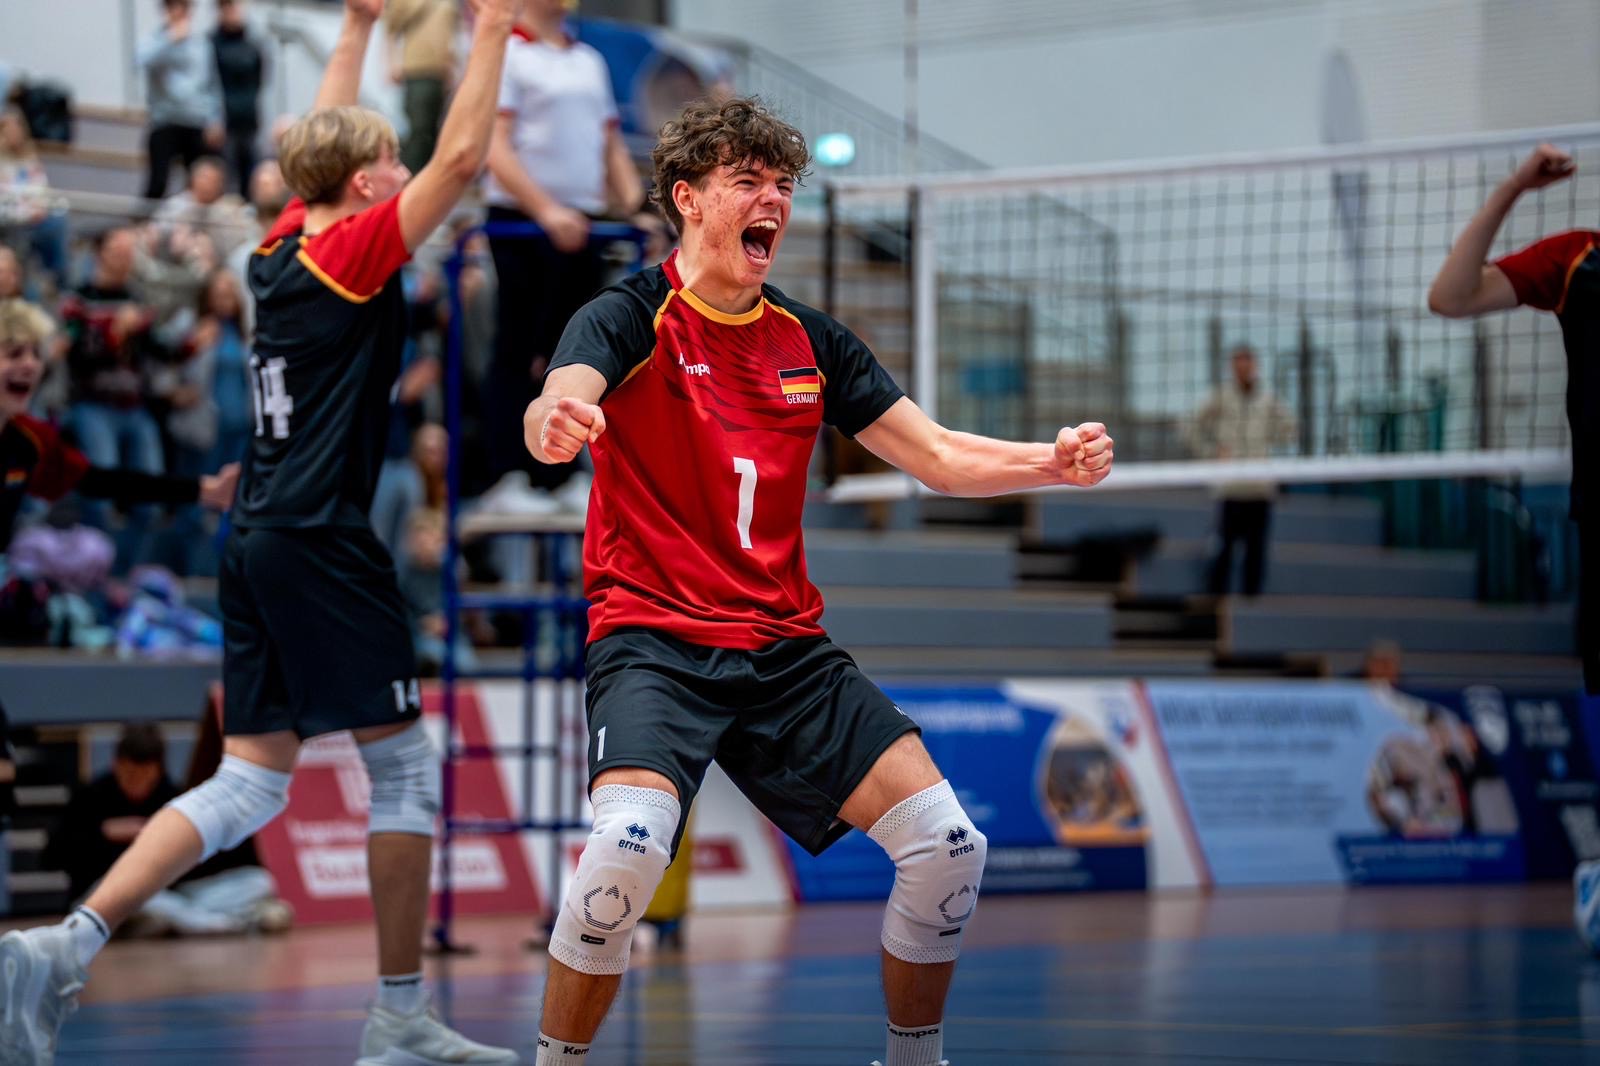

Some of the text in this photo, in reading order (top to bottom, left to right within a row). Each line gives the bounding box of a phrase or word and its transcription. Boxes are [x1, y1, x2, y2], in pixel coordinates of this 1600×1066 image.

[249, 353, 293, 439] 14
[786, 393, 818, 404] GERMANY
[733, 456, 758, 549] 1
[391, 677, 421, 713] 14
[597, 726, 606, 762] 1
[618, 839, 647, 855] errea
[949, 842, 975, 858] errea
